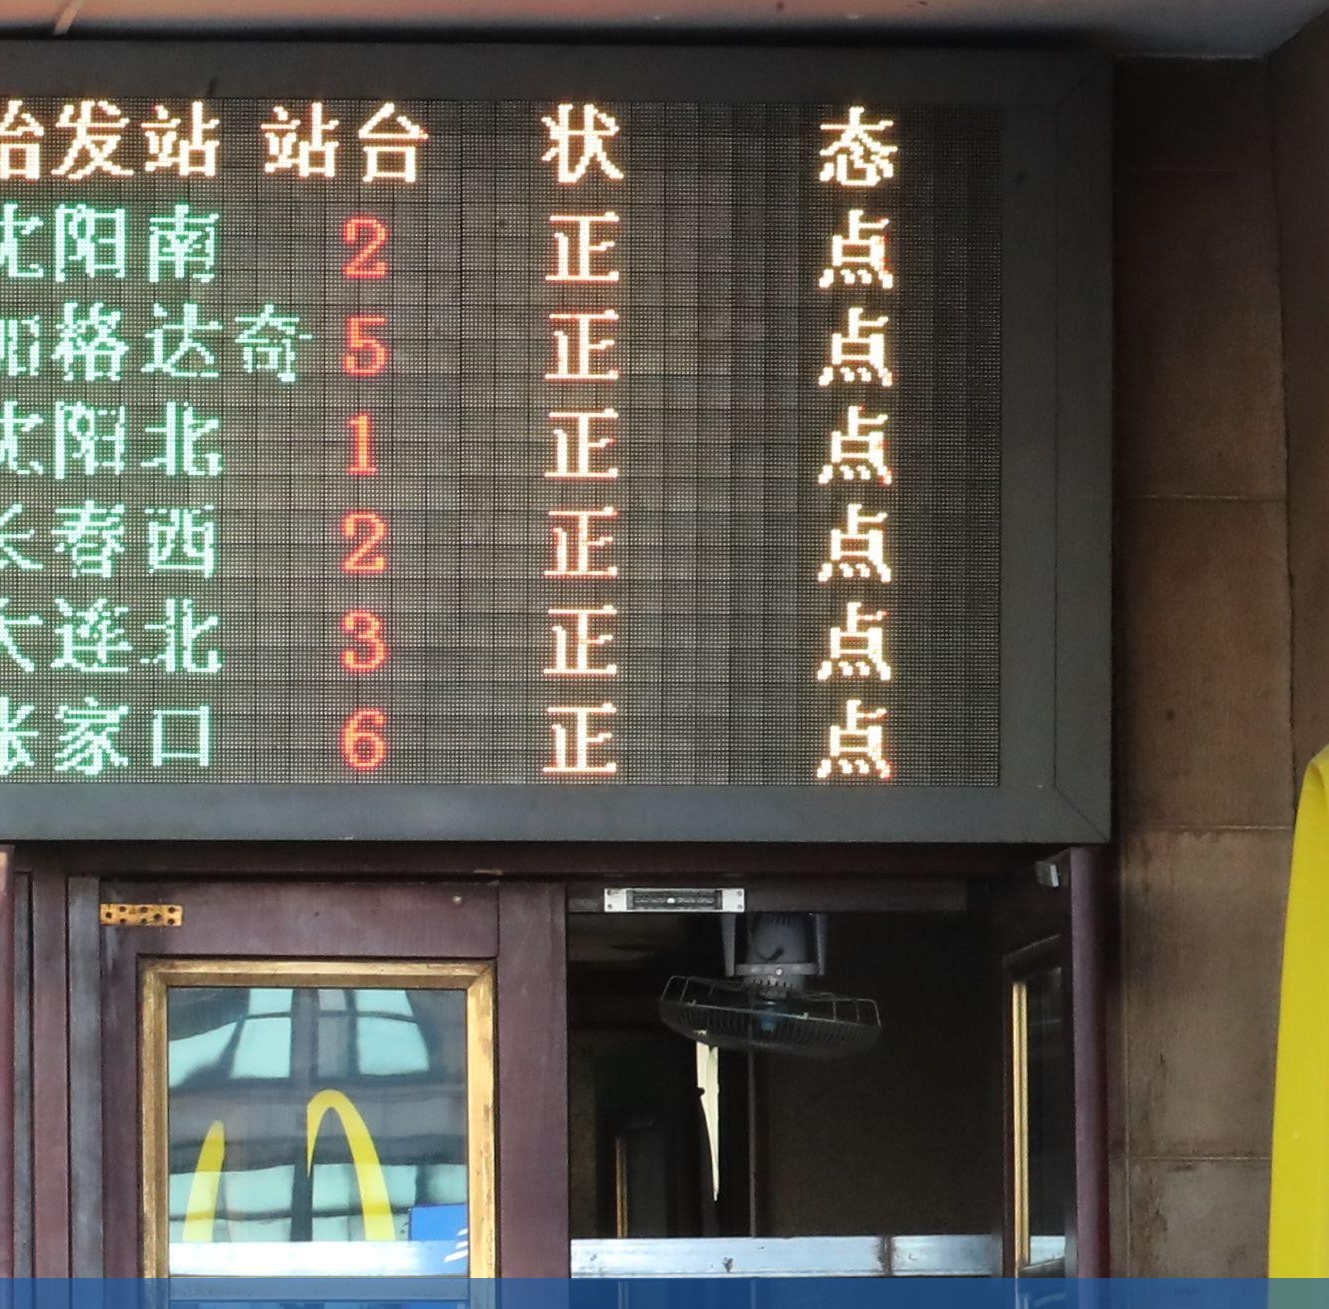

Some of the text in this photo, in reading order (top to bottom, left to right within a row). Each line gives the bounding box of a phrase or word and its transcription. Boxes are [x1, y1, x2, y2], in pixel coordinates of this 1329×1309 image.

[263, 104, 428, 183] 站台
[344, 218, 388, 279] 2
[344, 316, 388, 377] 5
[351, 414, 375, 476] 1
[343, 513, 387, 574] 2
[343, 611, 387, 673] 3
[343, 709, 387, 771] 6
